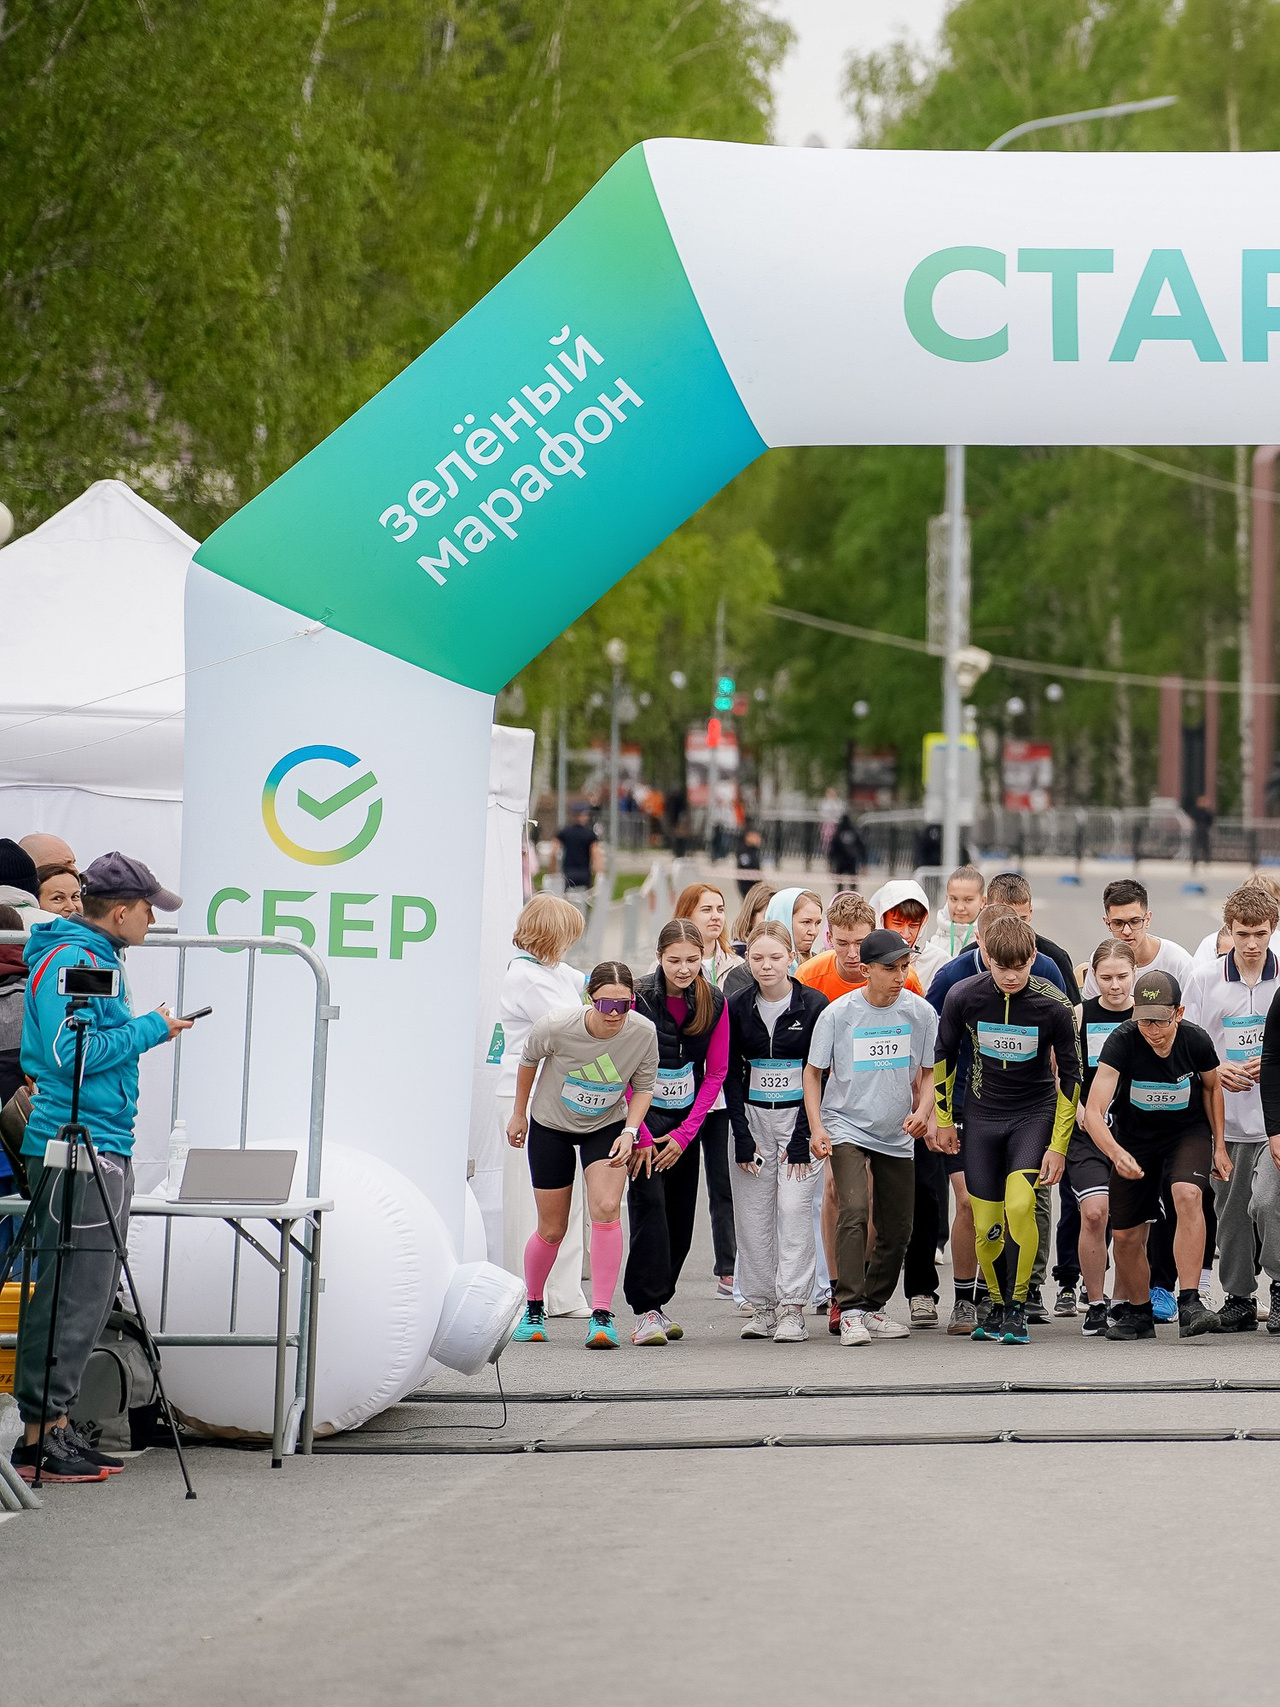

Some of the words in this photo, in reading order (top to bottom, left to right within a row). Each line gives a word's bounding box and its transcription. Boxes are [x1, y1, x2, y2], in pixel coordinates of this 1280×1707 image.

[378, 324, 605, 543] зелёный
[416, 376, 645, 586] марафон
[207, 887, 437, 960] СБЕР
[993, 1039, 1022, 1051] 3301
[1238, 1032, 1265, 1046] 3416
[869, 1043, 899, 1057] 3319
[760, 1076, 789, 1088] 3323
[576, 1093, 606, 1106] 3311
[1145, 1094, 1177, 1103] 3359
